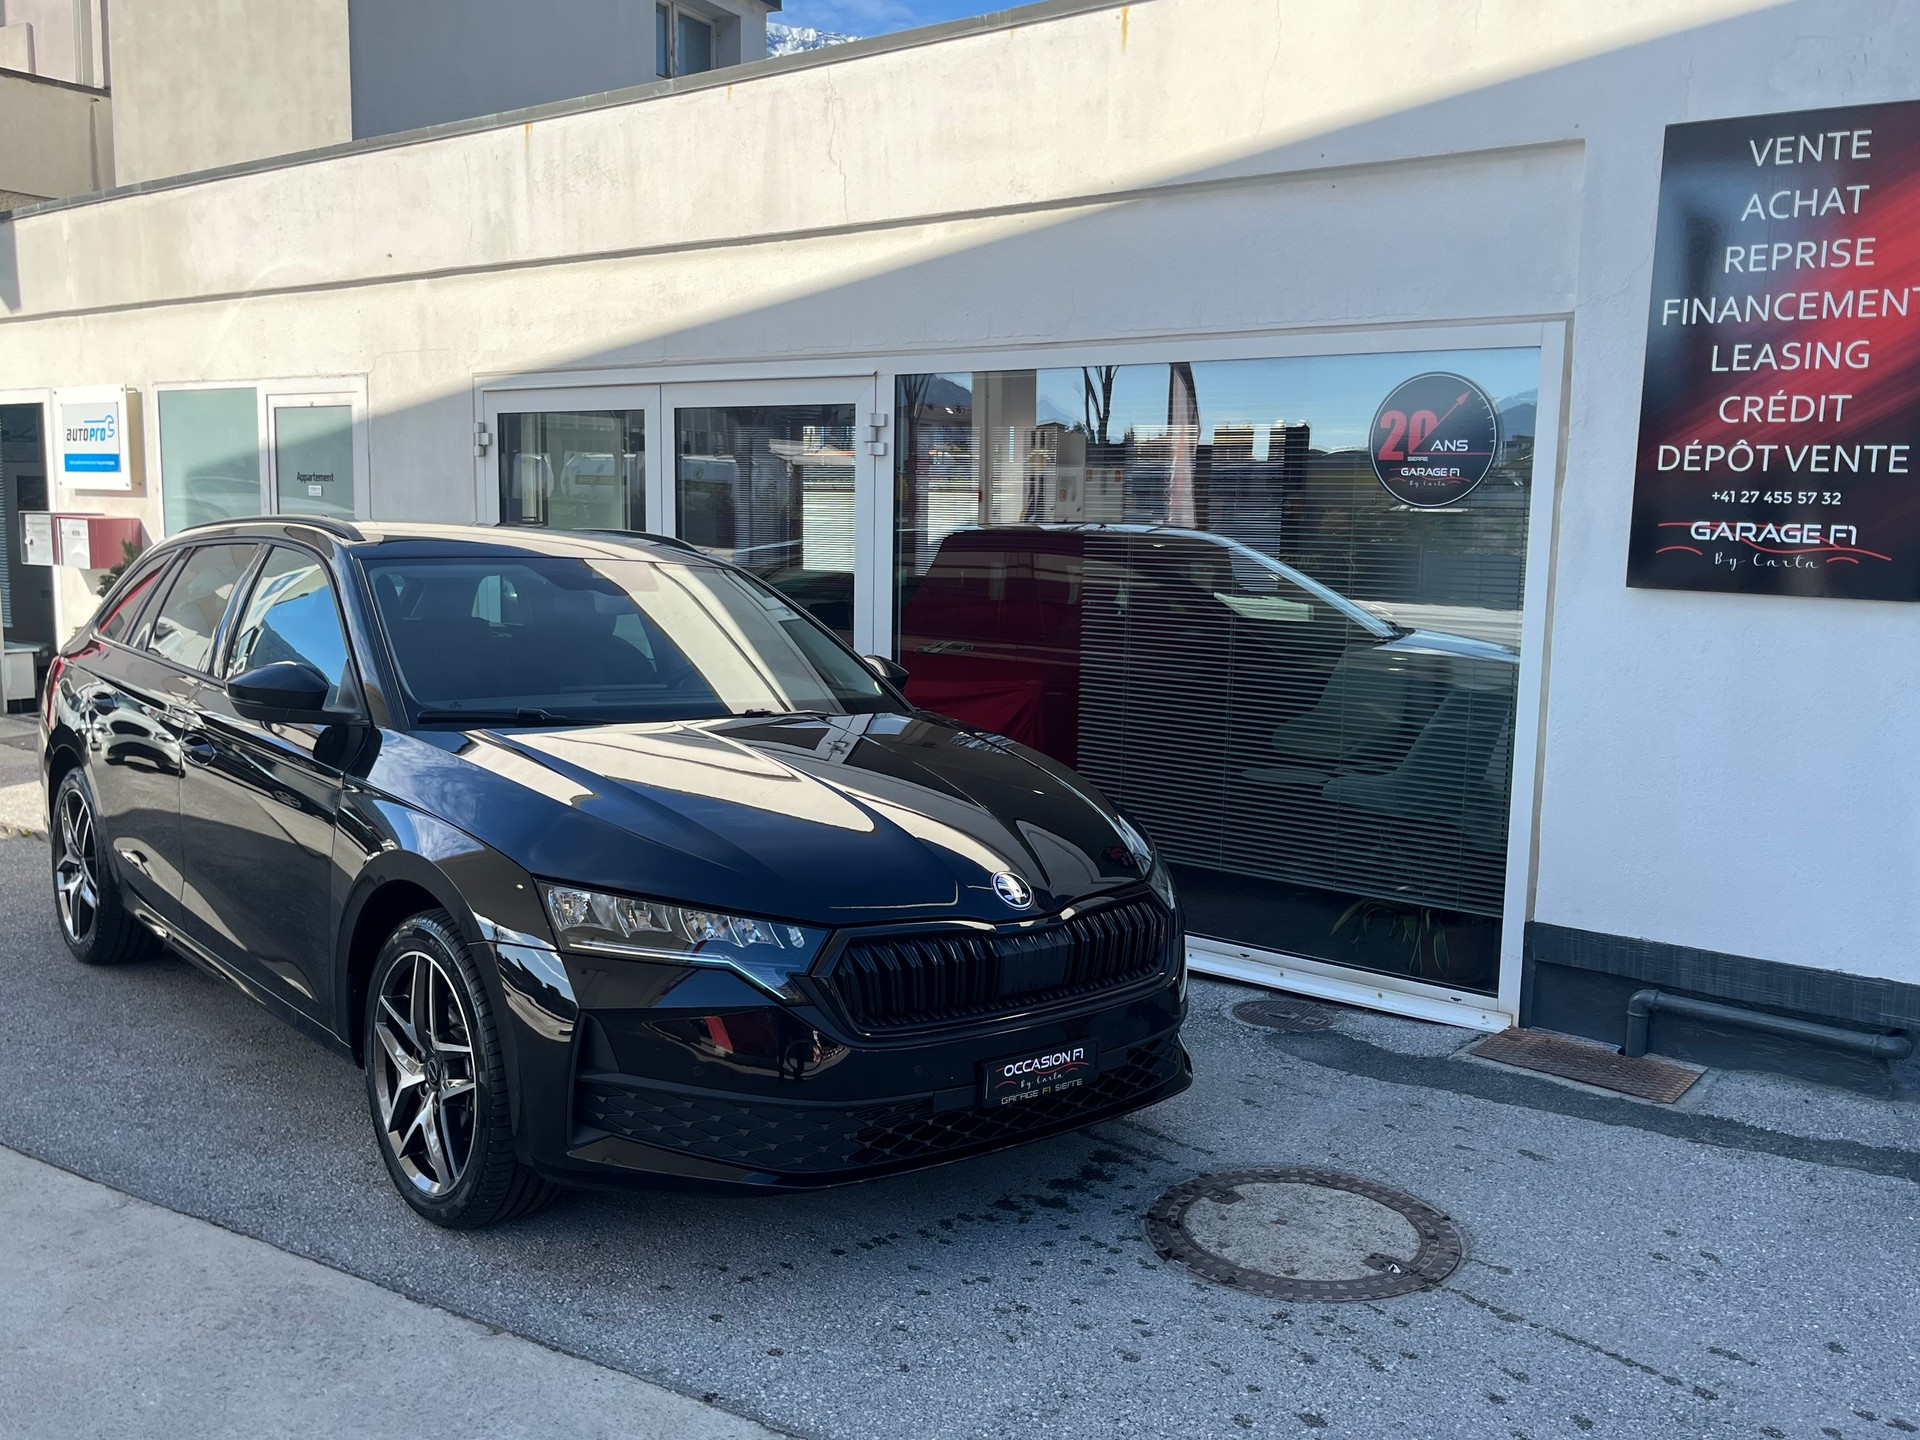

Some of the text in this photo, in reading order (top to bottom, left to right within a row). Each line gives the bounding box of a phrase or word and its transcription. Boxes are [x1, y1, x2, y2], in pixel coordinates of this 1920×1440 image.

[1750, 130, 1872, 167] VENTE
[1741, 185, 1870, 222] ACHAT
[1724, 237, 1876, 273] REPRISE
[1662, 287, 1920, 325] FINANCEMEN
[1711, 340, 1870, 372] LEASING
[1719, 389, 1852, 423] CRÉDIT
[1378, 409, 1469, 461] 20 ANS
[1657, 439, 1910, 473] DÉPÔT VENTE
[296, 471, 335, 484] Appartement
[1400, 467, 1460, 477] GARAGE F1
[1712, 490, 1842, 505] +41 27 455 57 32
[1690, 521, 1857, 546] GARAGE F1
[1714, 551, 1746, 572] By
[1004, 1047, 1084, 1077] OCCASION F1
[1020, 1079, 1033, 1090] By
[1042, 1086, 1051, 1095] F1
